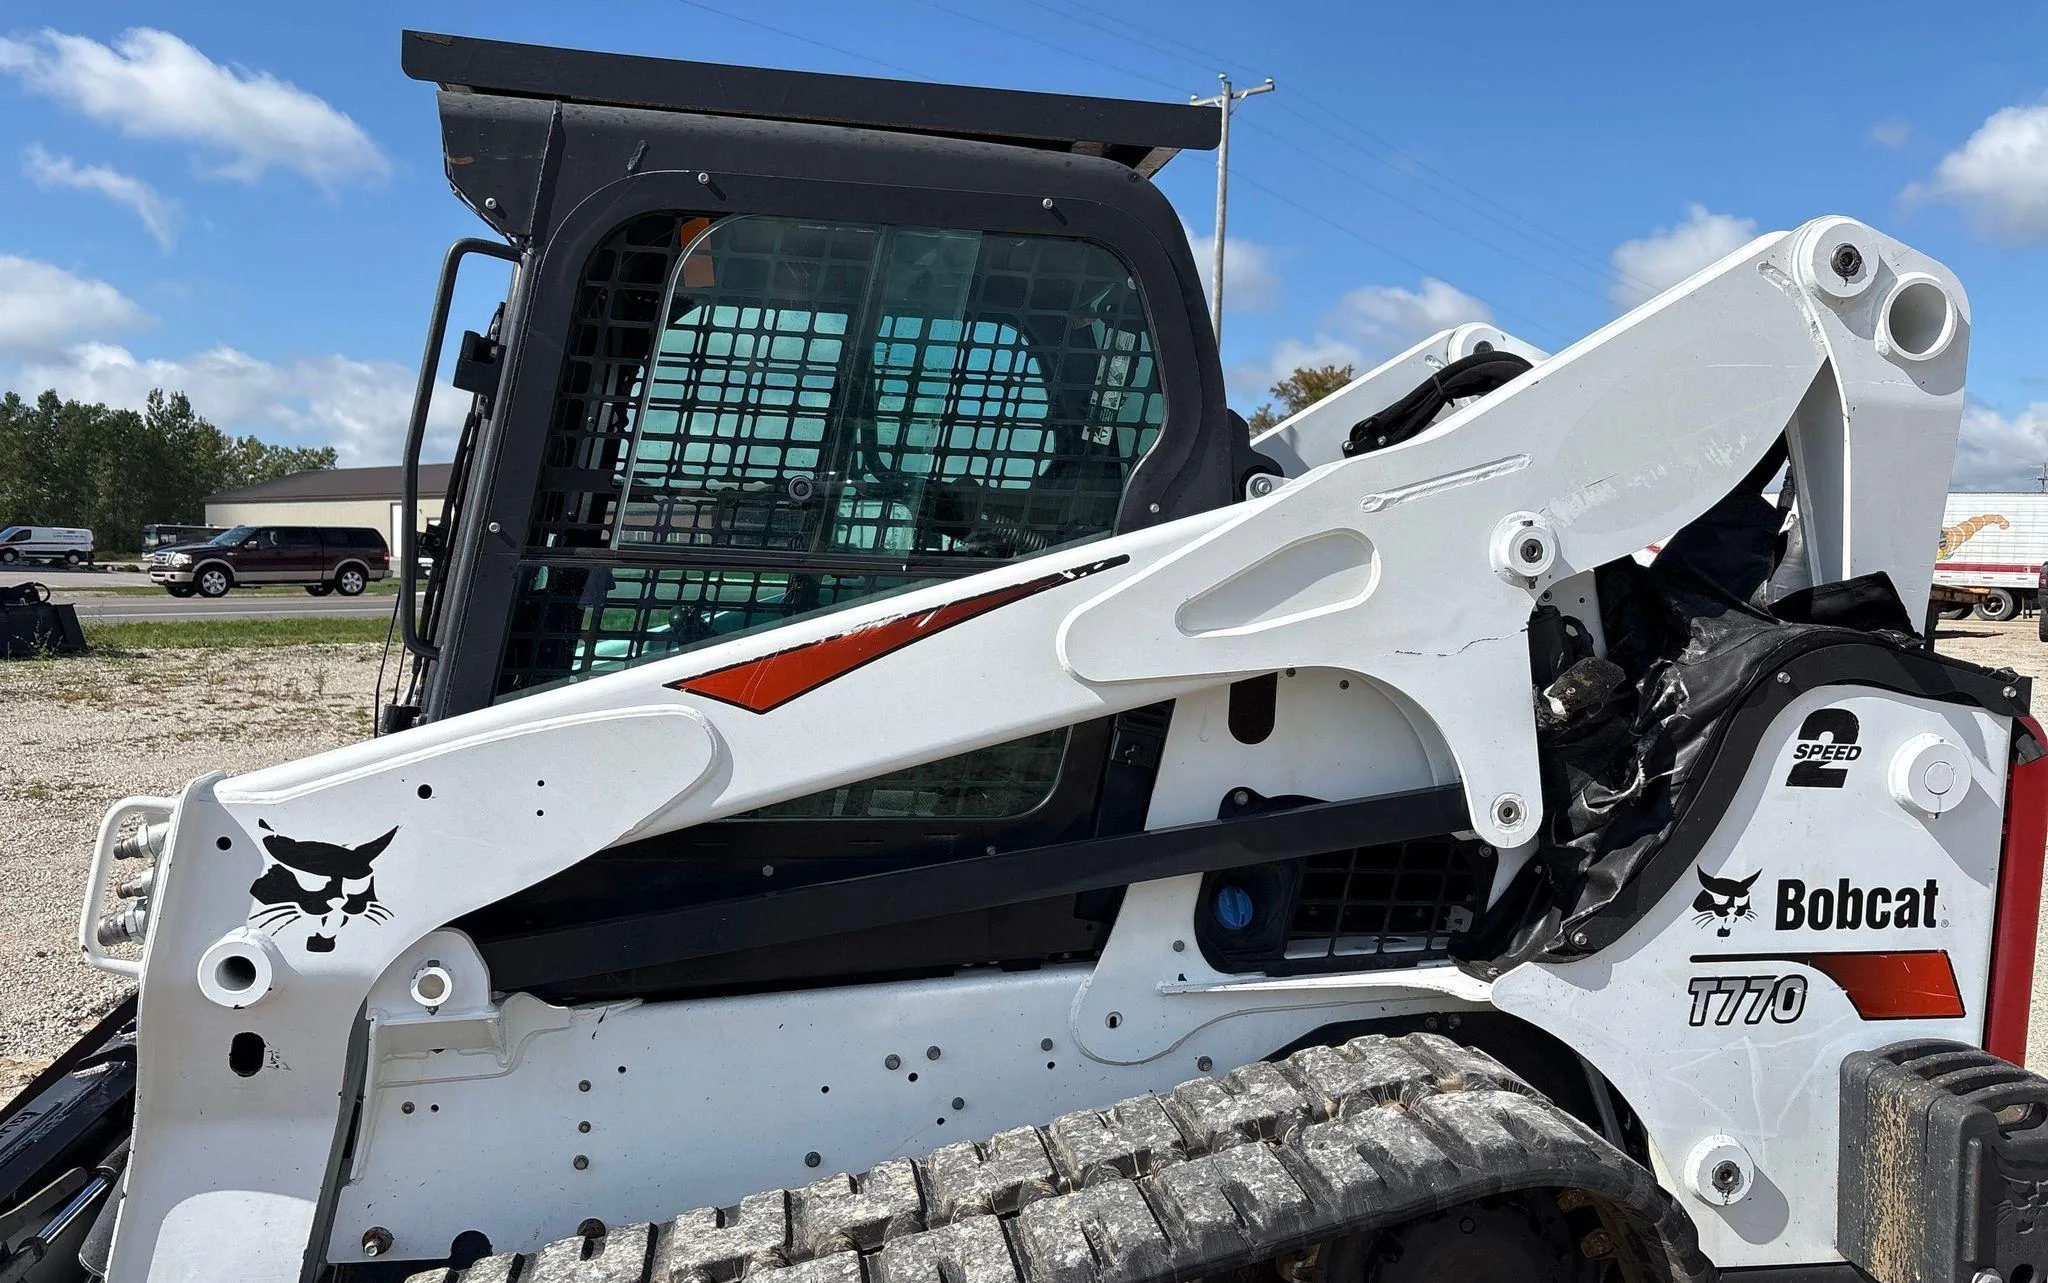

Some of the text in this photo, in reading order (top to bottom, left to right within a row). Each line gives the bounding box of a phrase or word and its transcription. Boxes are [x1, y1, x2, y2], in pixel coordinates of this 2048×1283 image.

[1785, 708, 1860, 788] 2
[1793, 743, 1862, 762] SPEED
[1775, 878, 1939, 931] Bobcat
[1687, 974, 1808, 1026] T770
